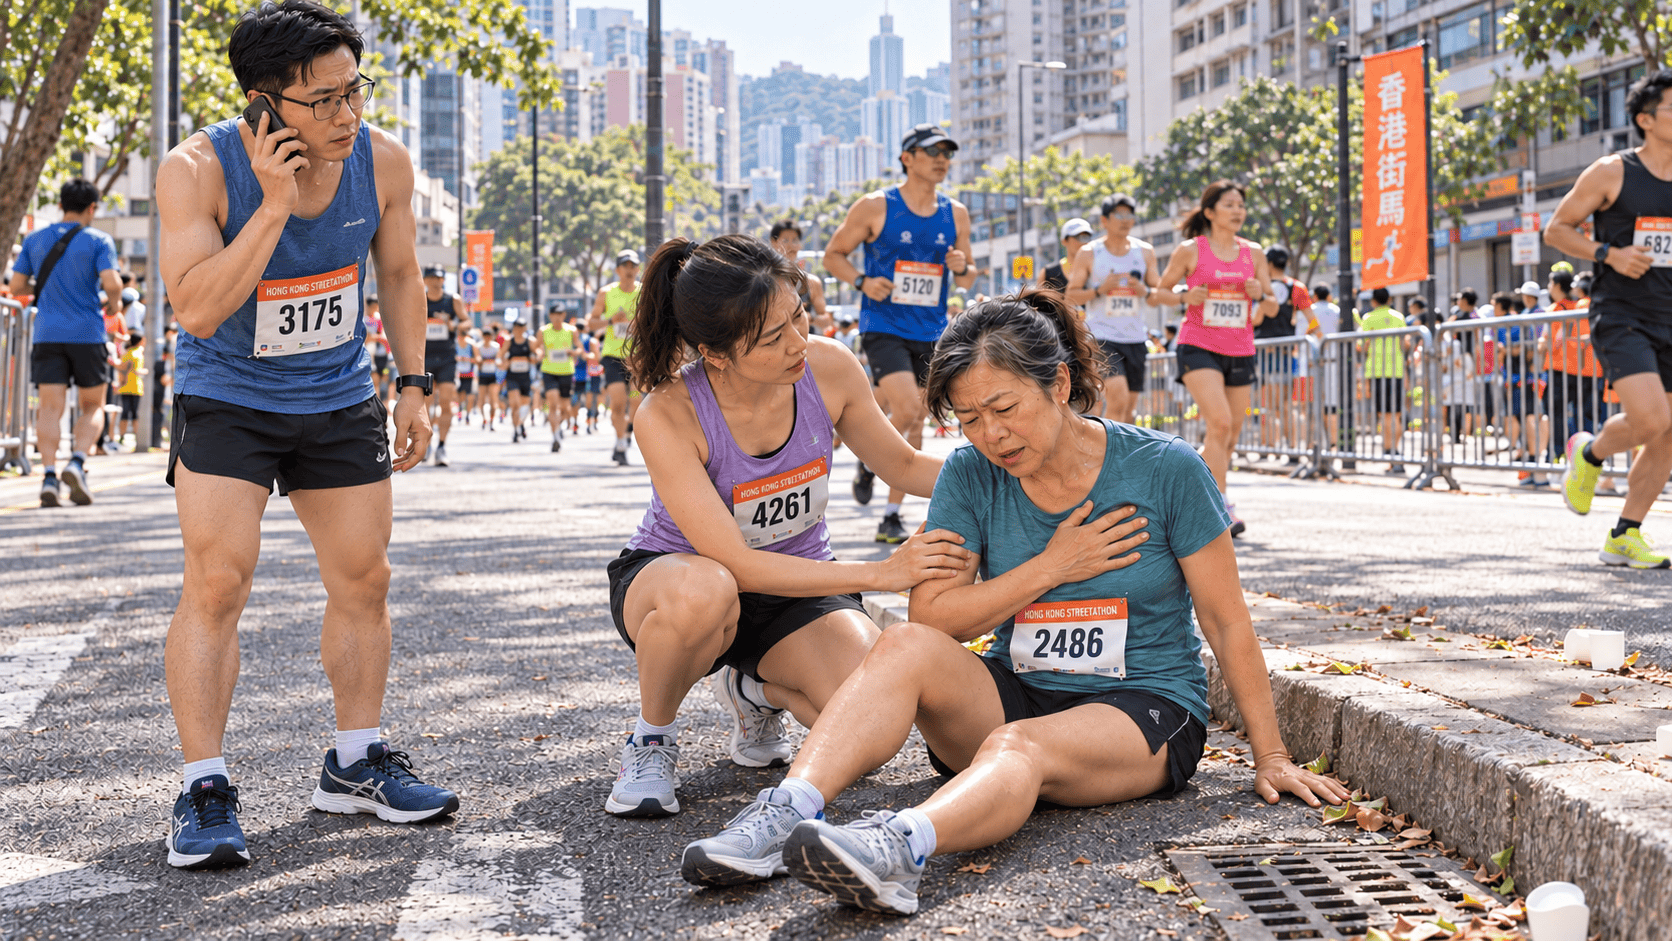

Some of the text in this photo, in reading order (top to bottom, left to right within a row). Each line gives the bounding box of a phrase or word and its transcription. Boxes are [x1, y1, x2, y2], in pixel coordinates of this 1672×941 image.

[1376, 71, 1407, 227] 香港街馬
[266, 286, 288, 296] HONG
[289, 283, 310, 295] KONG
[902, 277, 934, 295] 5120
[279, 294, 342, 336] 3175
[1212, 303, 1242, 317] 7093
[751, 486, 810, 529] 4261
[1024, 605, 1118, 620] HONG KONG STREETATHON
[1033, 627, 1104, 658] 2486
